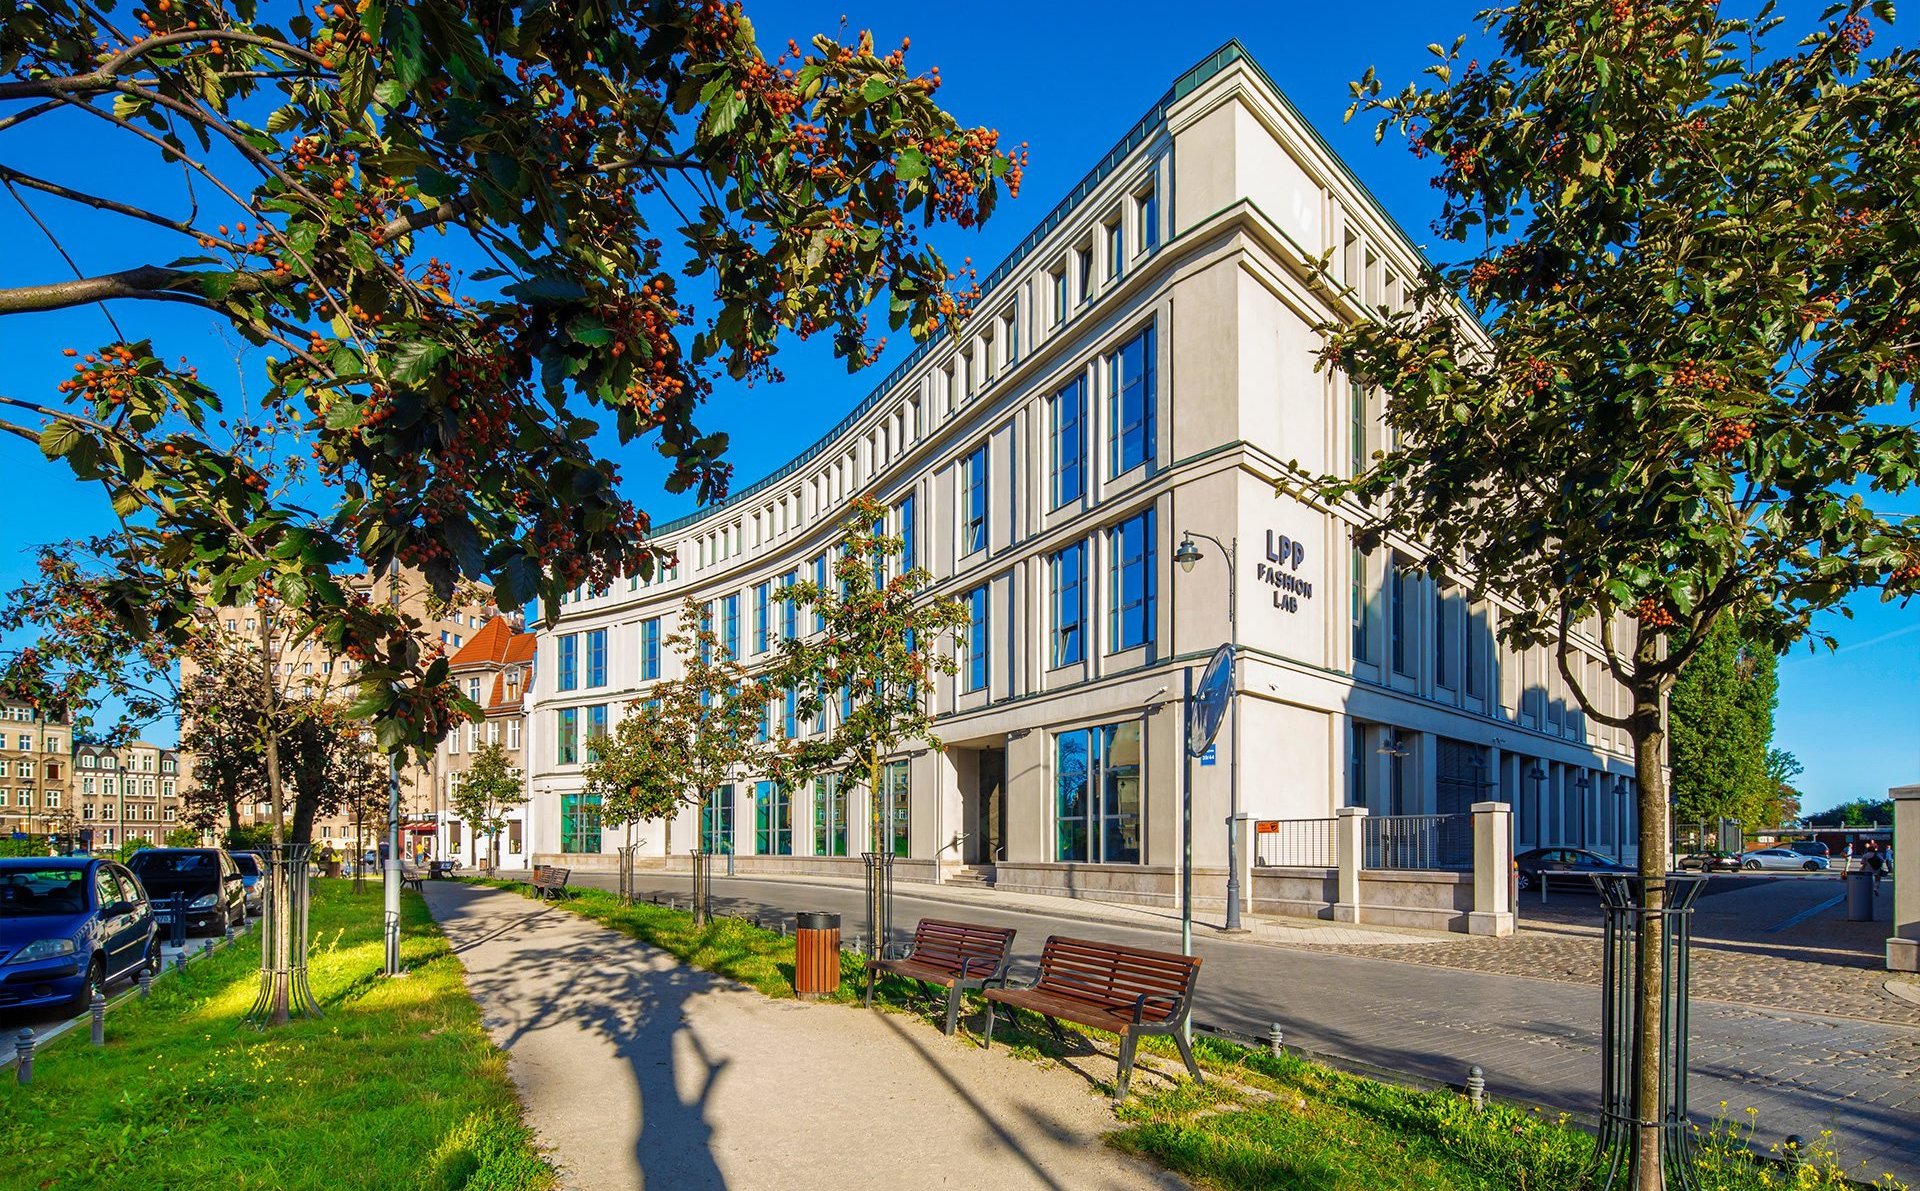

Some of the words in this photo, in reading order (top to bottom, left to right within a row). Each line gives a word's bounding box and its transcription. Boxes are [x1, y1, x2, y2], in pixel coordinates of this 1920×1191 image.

[1266, 529, 1304, 571] LPP
[1257, 563, 1312, 600] FASHION
[1273, 591, 1298, 613] LAB
